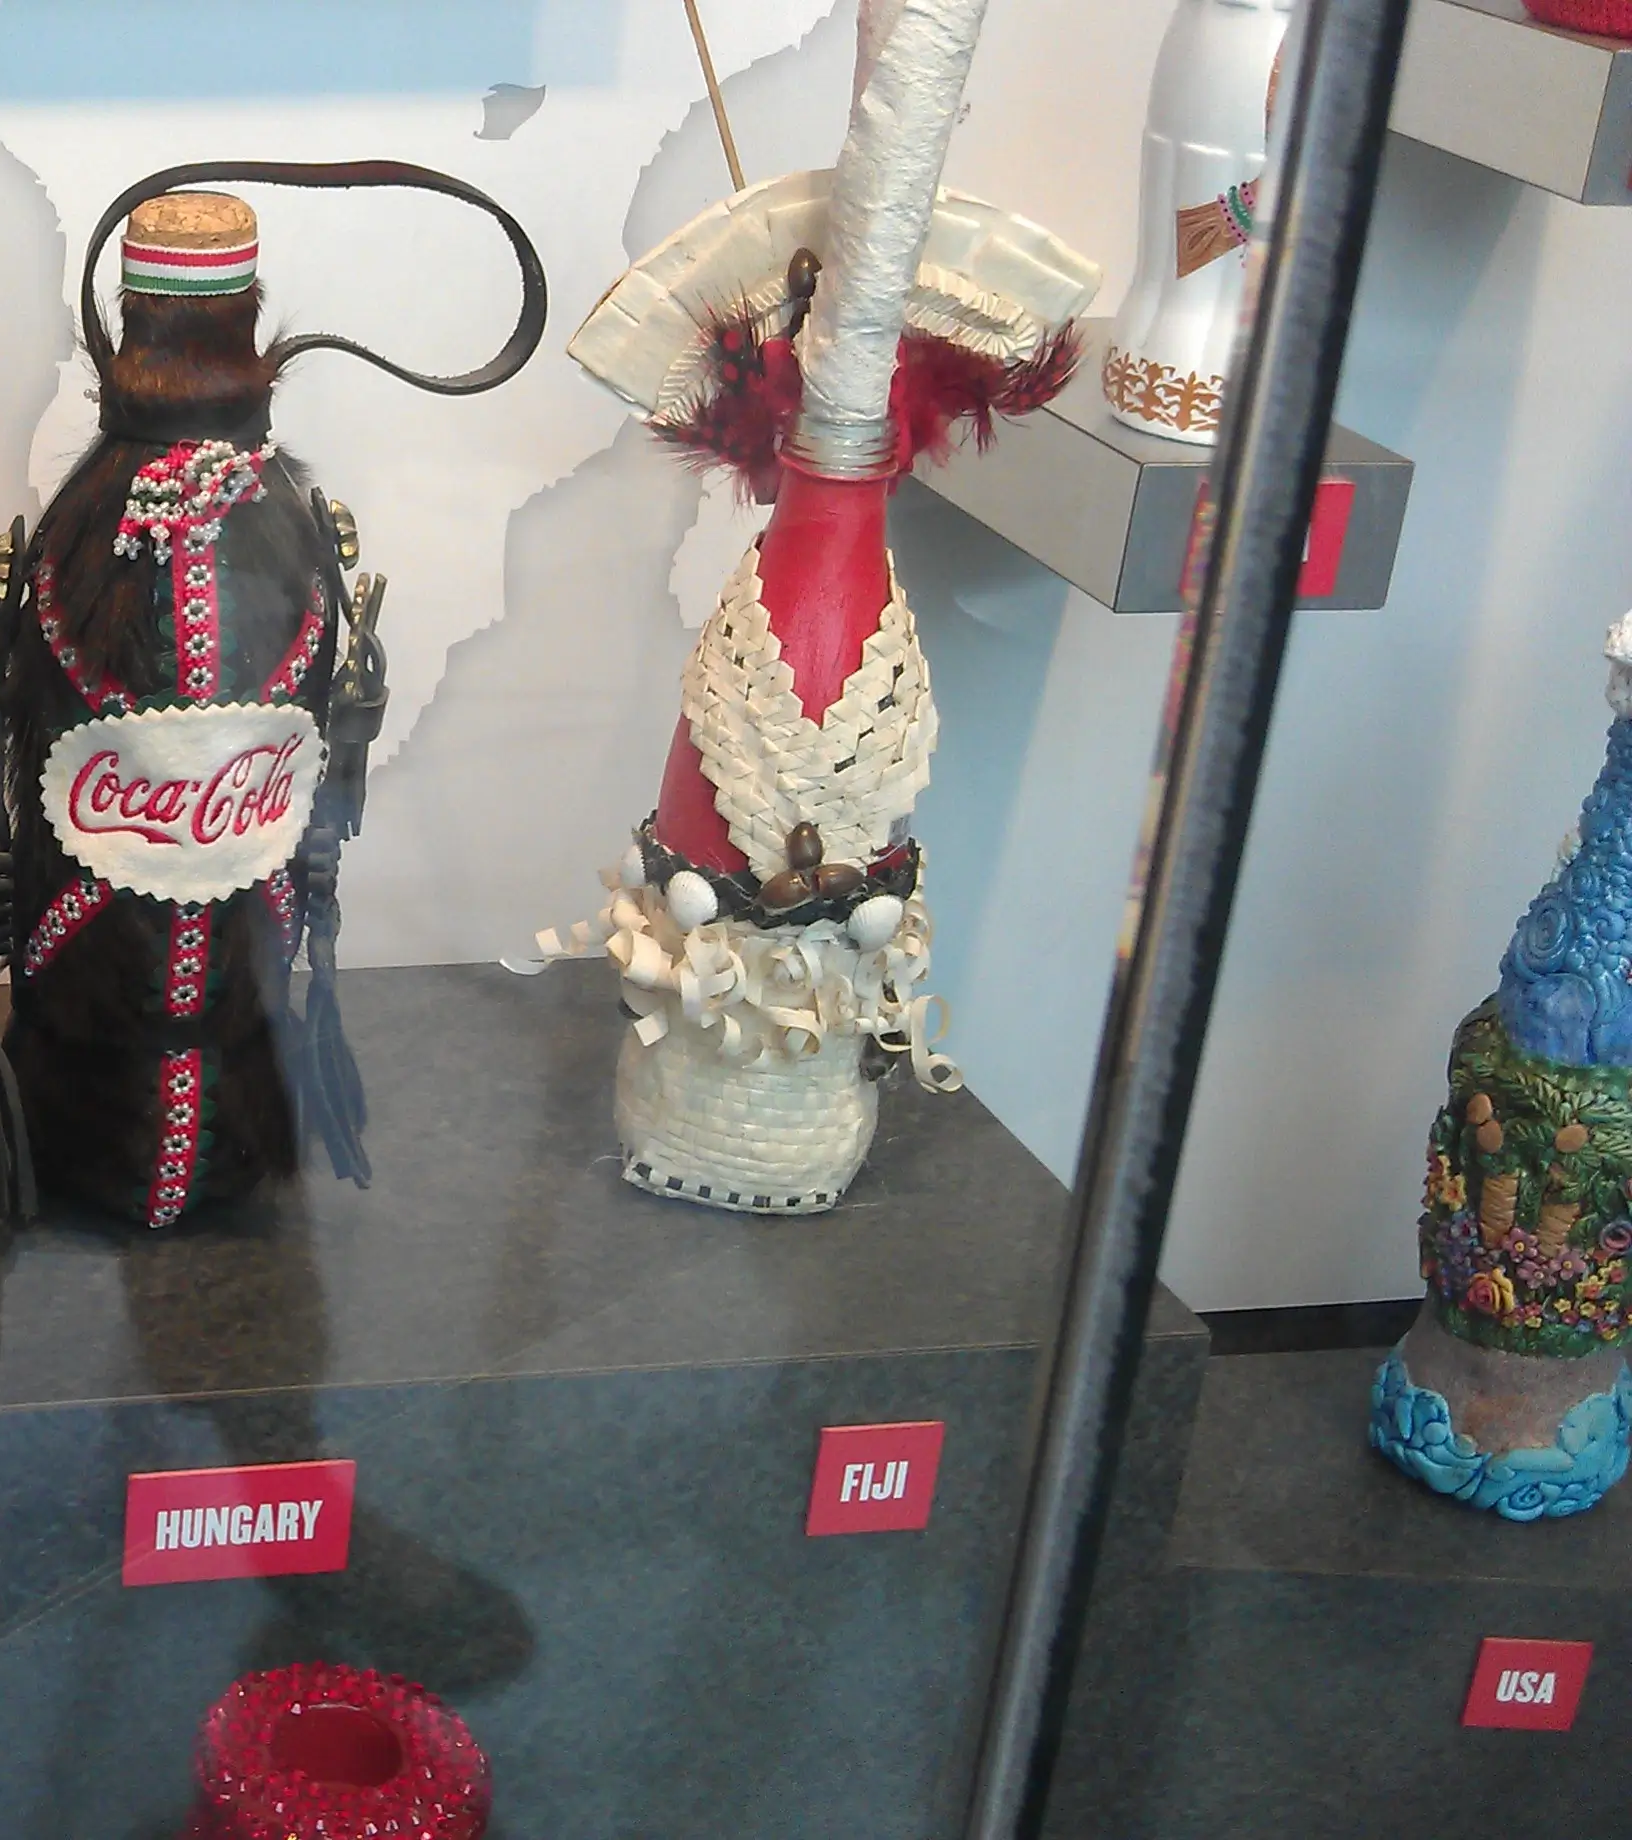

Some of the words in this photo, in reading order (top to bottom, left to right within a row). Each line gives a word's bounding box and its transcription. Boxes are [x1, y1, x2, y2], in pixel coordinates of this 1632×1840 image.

[839, 1460, 909, 1503] FIJI
[155, 1500, 324, 1550] HUNGARY
[1495, 1670, 1556, 1704] USA
